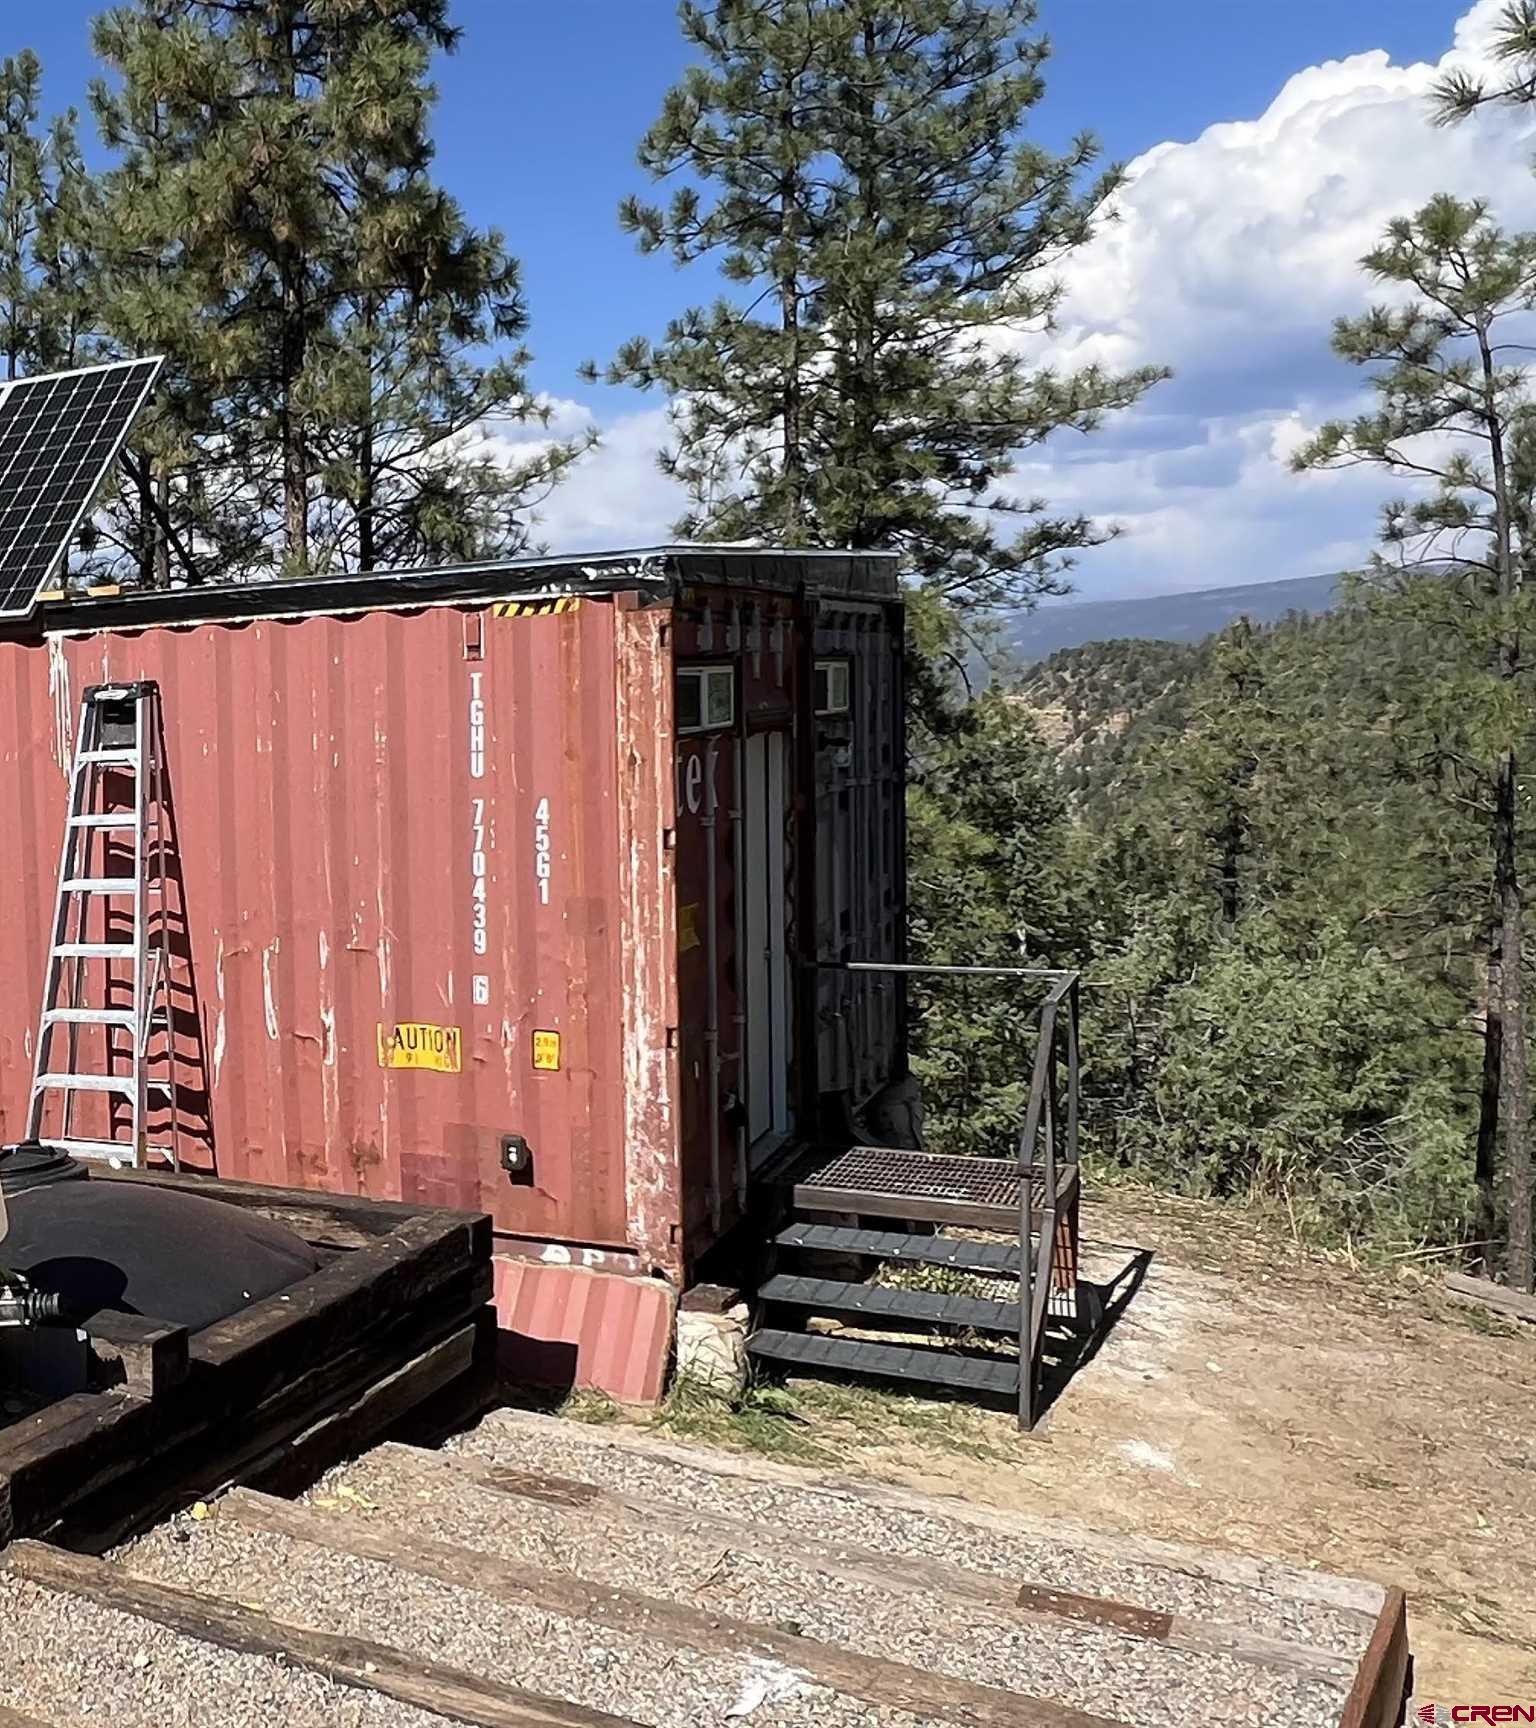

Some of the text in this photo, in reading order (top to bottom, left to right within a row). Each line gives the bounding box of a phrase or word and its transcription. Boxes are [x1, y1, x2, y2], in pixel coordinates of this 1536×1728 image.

[470, 672, 489, 1005] TGHU 770439 6
[535, 798, 550, 905] 45G1
[384, 1025, 457, 1052] AUTION
